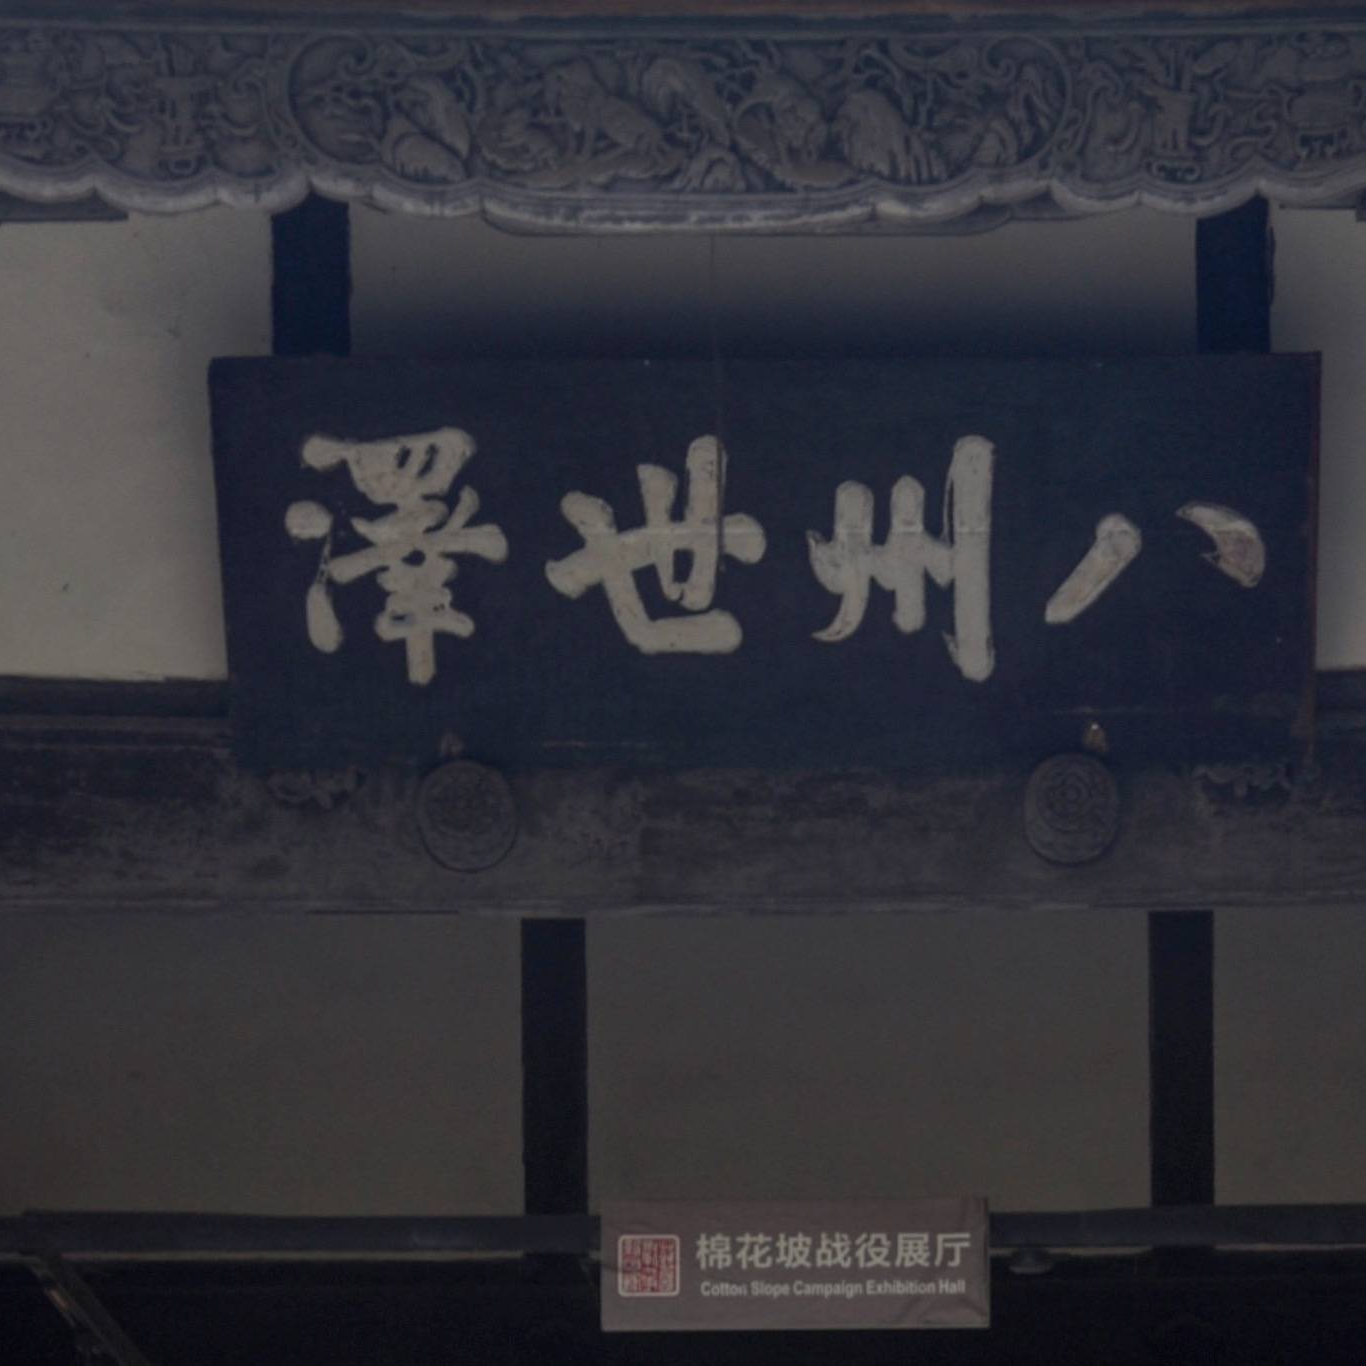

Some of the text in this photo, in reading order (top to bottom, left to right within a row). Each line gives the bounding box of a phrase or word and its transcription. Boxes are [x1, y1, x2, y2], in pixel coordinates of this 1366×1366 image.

[696, 1233, 971, 1270] 棉花坡战役展厅
[701, 1279, 966, 1298] Cotton Slope Campaign Exhibition Hall
